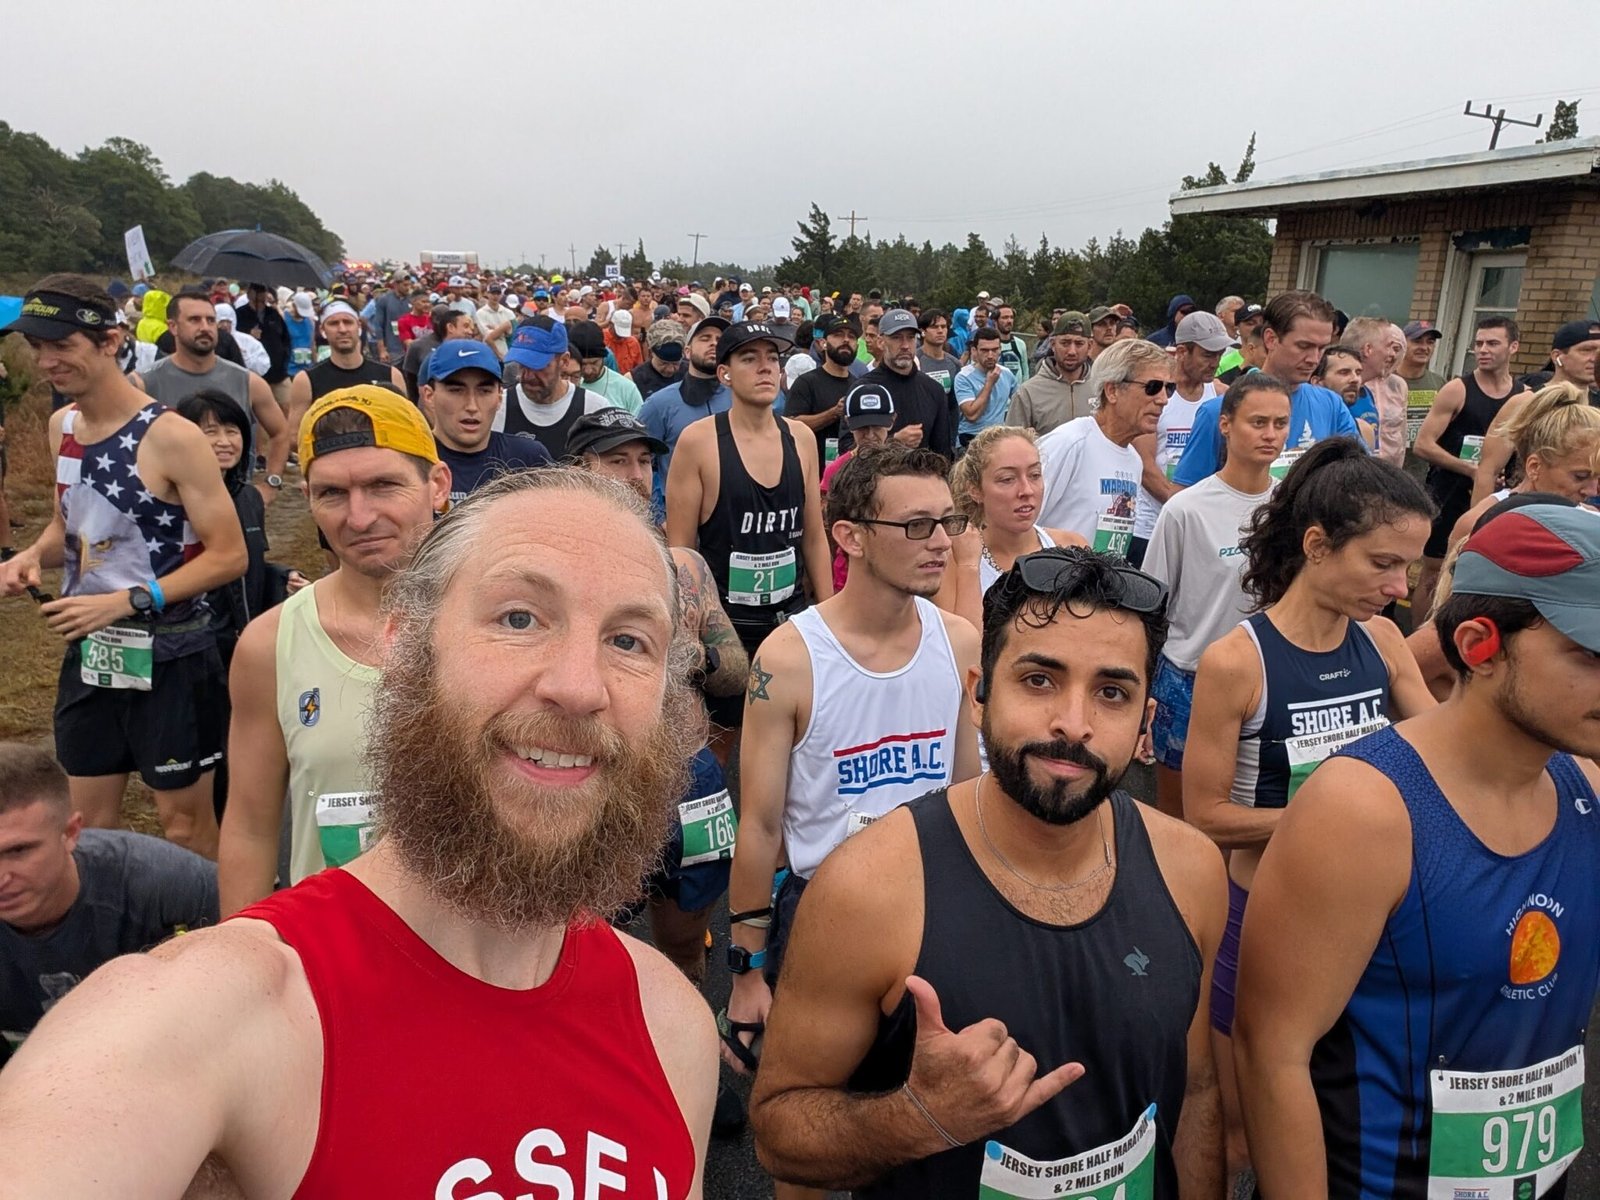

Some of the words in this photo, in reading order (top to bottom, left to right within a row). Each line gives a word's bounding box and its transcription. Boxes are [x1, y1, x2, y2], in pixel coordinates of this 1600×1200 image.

[740, 506, 799, 534] DIRTY
[753, 569, 775, 592] 21
[86, 641, 124, 672] 585
[1319, 671, 1343, 681] CRAFT
[1291, 704, 1354, 736] SHORE
[1297, 737, 1322, 749] JERSEY
[1322, 731, 1344, 744] SHORE
[1345, 728, 1360, 740] HALF
[837, 746, 908, 785] SHORE
[911, 741, 945, 770] A.C.
[327, 796, 358, 808] JERSEY
[686, 802, 702, 811] JERSEY
[701, 797, 717, 808] SHORE
[704, 813, 735, 849] 166
[1449, 1076, 1489, 1091] JERSEY
[1491, 1074, 1524, 1089] SHORE
[1525, 1069, 1544, 1084] HALF
[1544, 1051, 1577, 1078] MARATHON
[1499, 1096, 1506, 1106] &
[1508, 1093, 1514, 1105] 2
[1516, 1088, 1536, 1103] MILE
[1536, 1083, 1553, 1098] RUN
[1000, 1152, 1042, 1178] JERSEY
[1045, 1160, 1084, 1178] SHORE
[1086, 1150, 1112, 1169] HALF
[1113, 1118, 1149, 1158] MARATHON
[1482, 1105, 1556, 1173] 979
[1053, 1185, 1063, 1194] &
[1065, 1179, 1073, 1191] 2
[1075, 1173, 1101, 1189] MILE
[1103, 1161, 1125, 1182] RUN
[1454, 1190, 1476, 1199] SHORE
